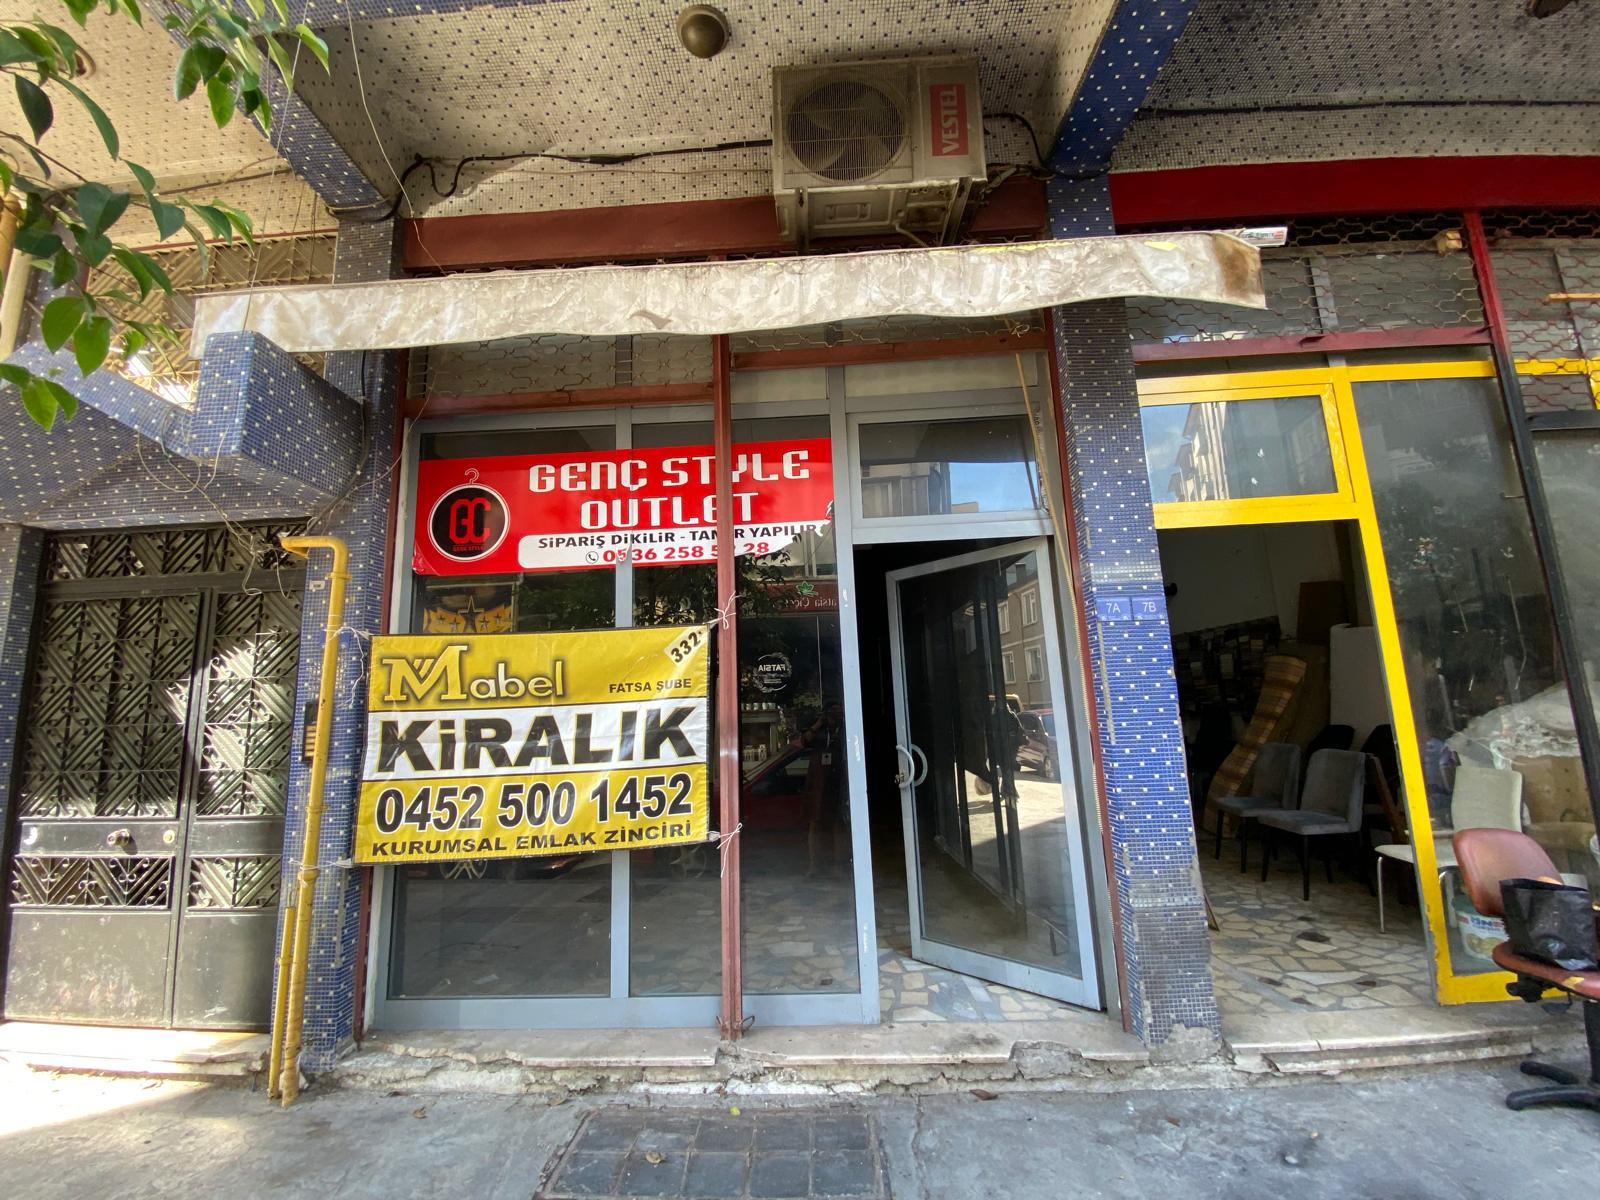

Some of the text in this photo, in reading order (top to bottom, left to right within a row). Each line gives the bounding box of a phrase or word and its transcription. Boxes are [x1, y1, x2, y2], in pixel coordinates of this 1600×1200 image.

[940, 86, 960, 154] VESTEL
[529, 459, 647, 492] GENÇ
[663, 546, 704, 559] 258
[1106, 603, 1121, 613] 7A
[1142, 602, 1157, 613] 7B
[382, 645, 564, 701] Mabel
[609, 681, 652, 694] FATSA
[376, 772, 694, 834] 0452 500 1452
[372, 819, 692, 857] KURUMSAL EMLAK ZİNCİRİ
